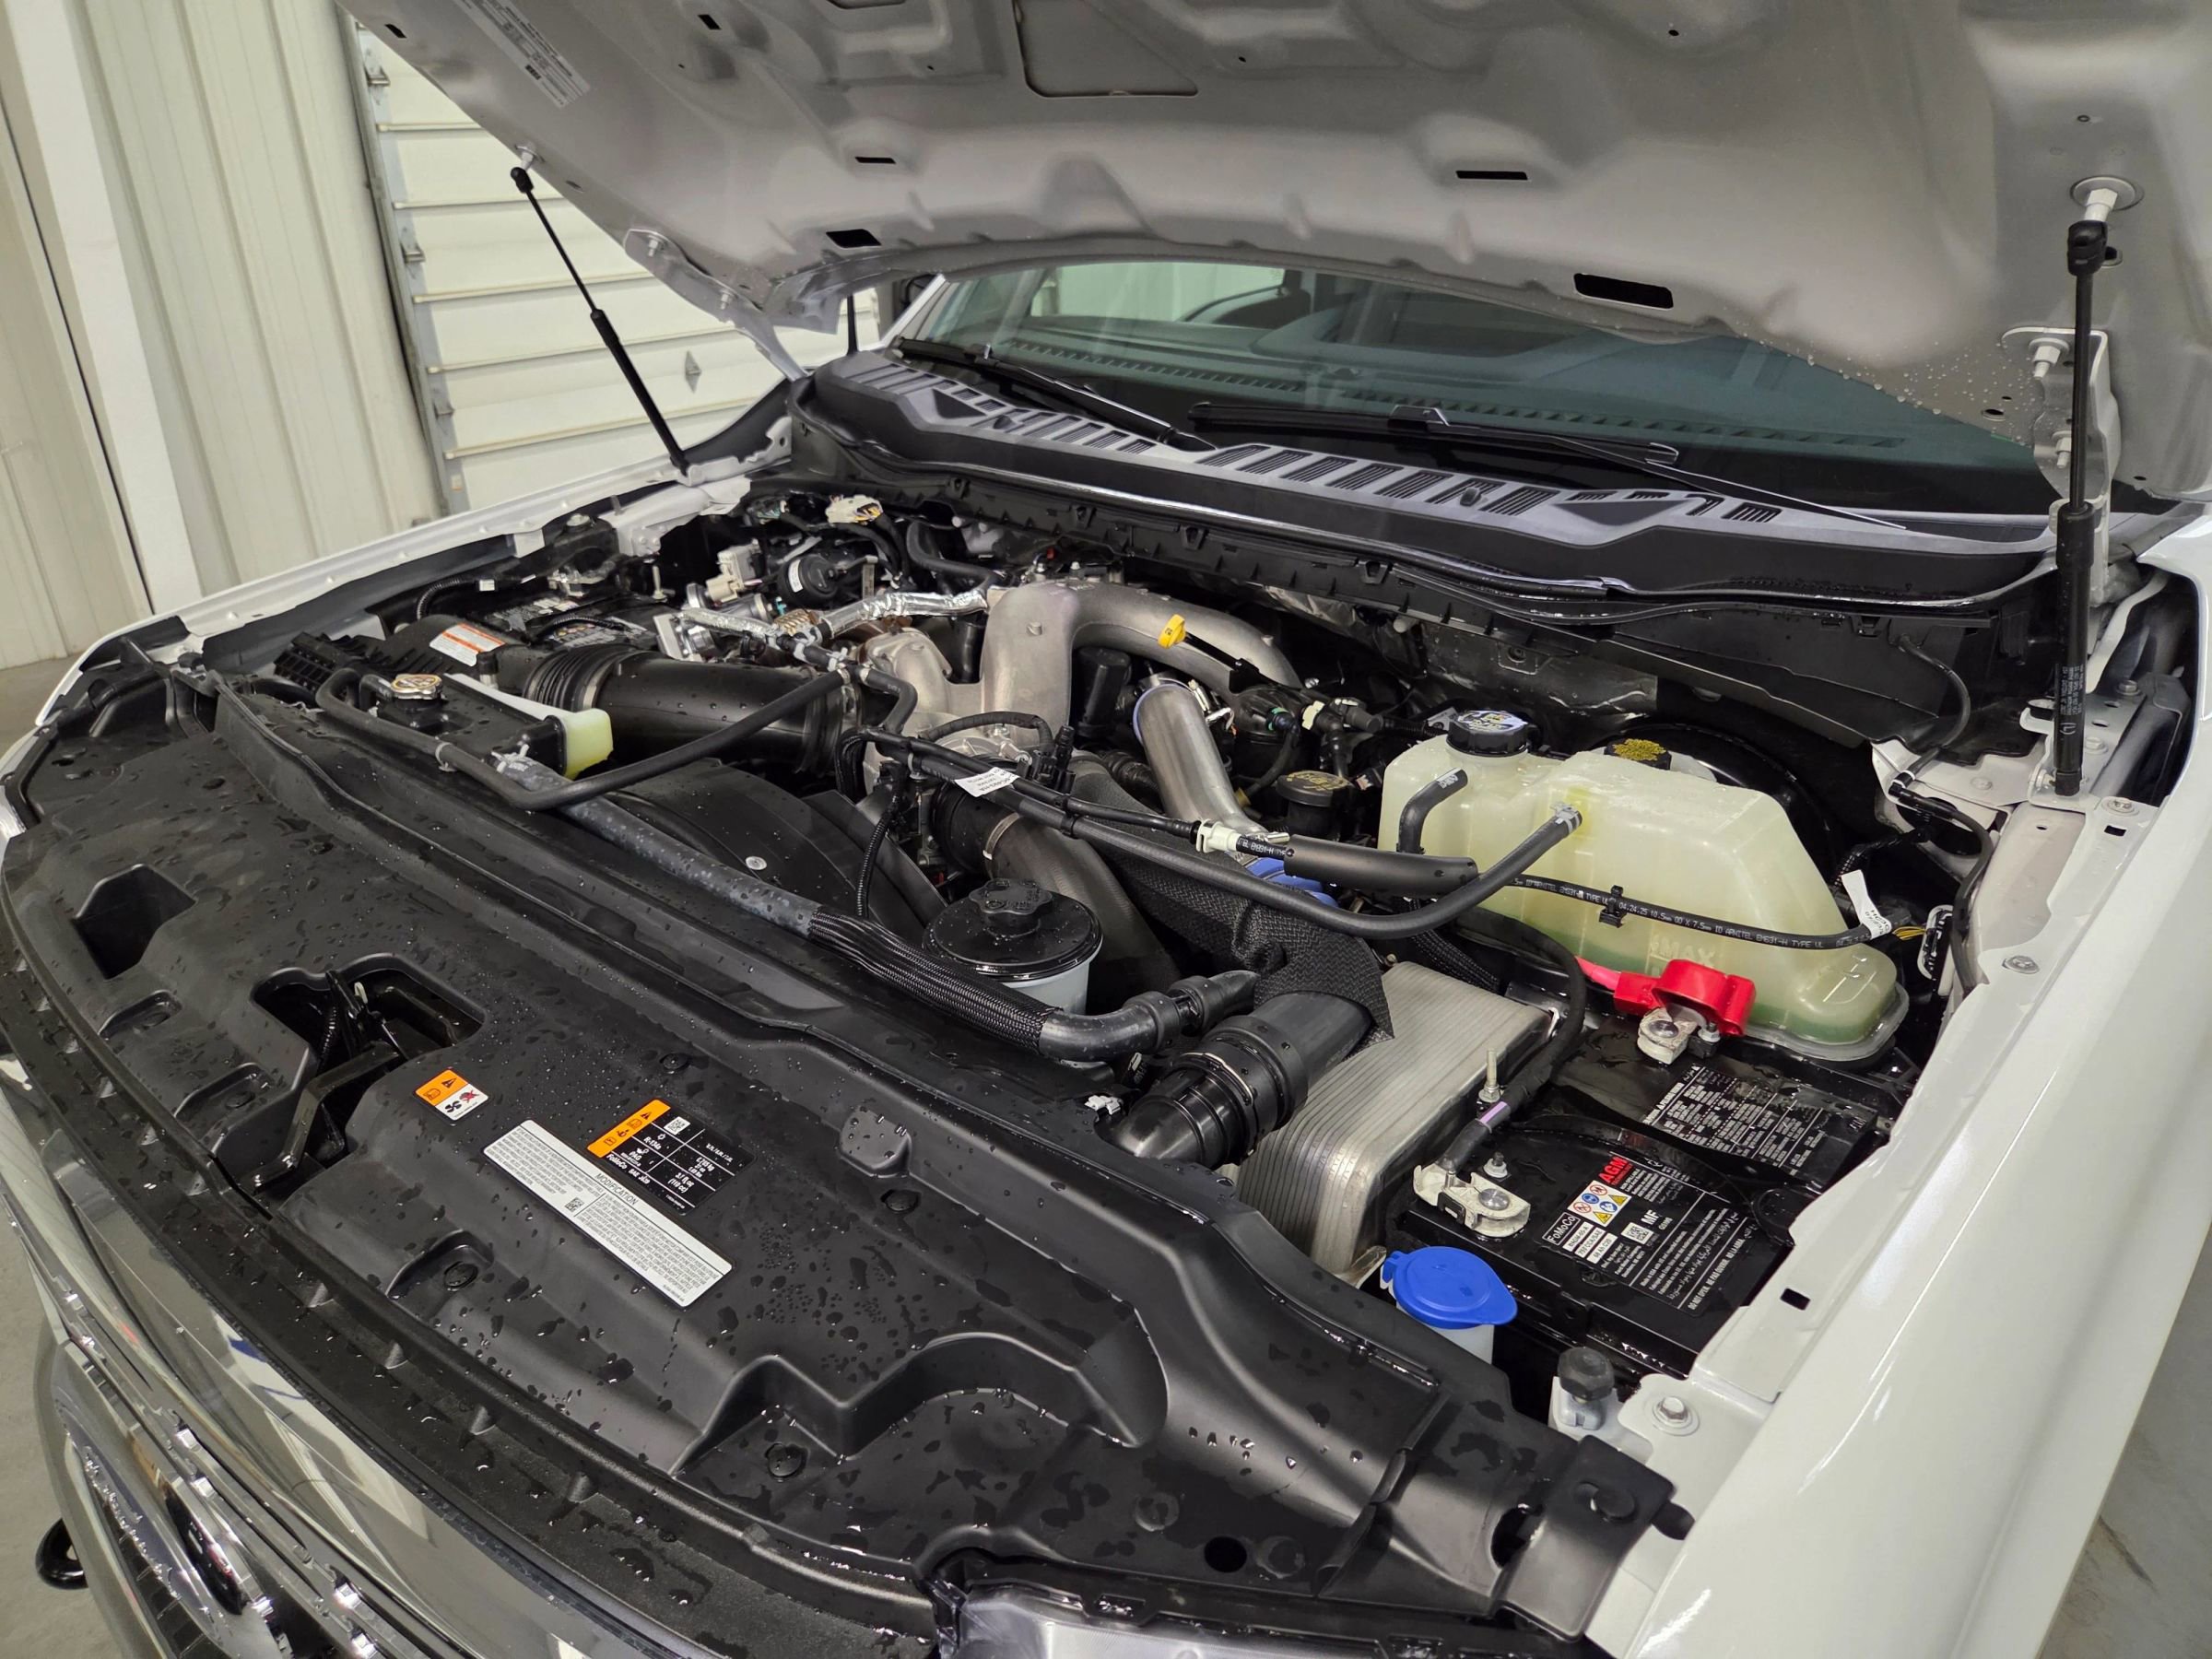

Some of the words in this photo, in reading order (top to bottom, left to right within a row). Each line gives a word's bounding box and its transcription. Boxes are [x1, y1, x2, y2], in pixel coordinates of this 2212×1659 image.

[1618, 900, 1648, 916] 04.24.25
[643, 1136, 661, 1149] R-134a
[629, 1151, 641, 1160] PAG
[1598, 1156, 1630, 1184] AGM
[595, 1172, 639, 1206] MODIFICATION
[1641, 1210, 1659, 1225] MF
[1547, 1214, 1577, 1243] FoMoCo
